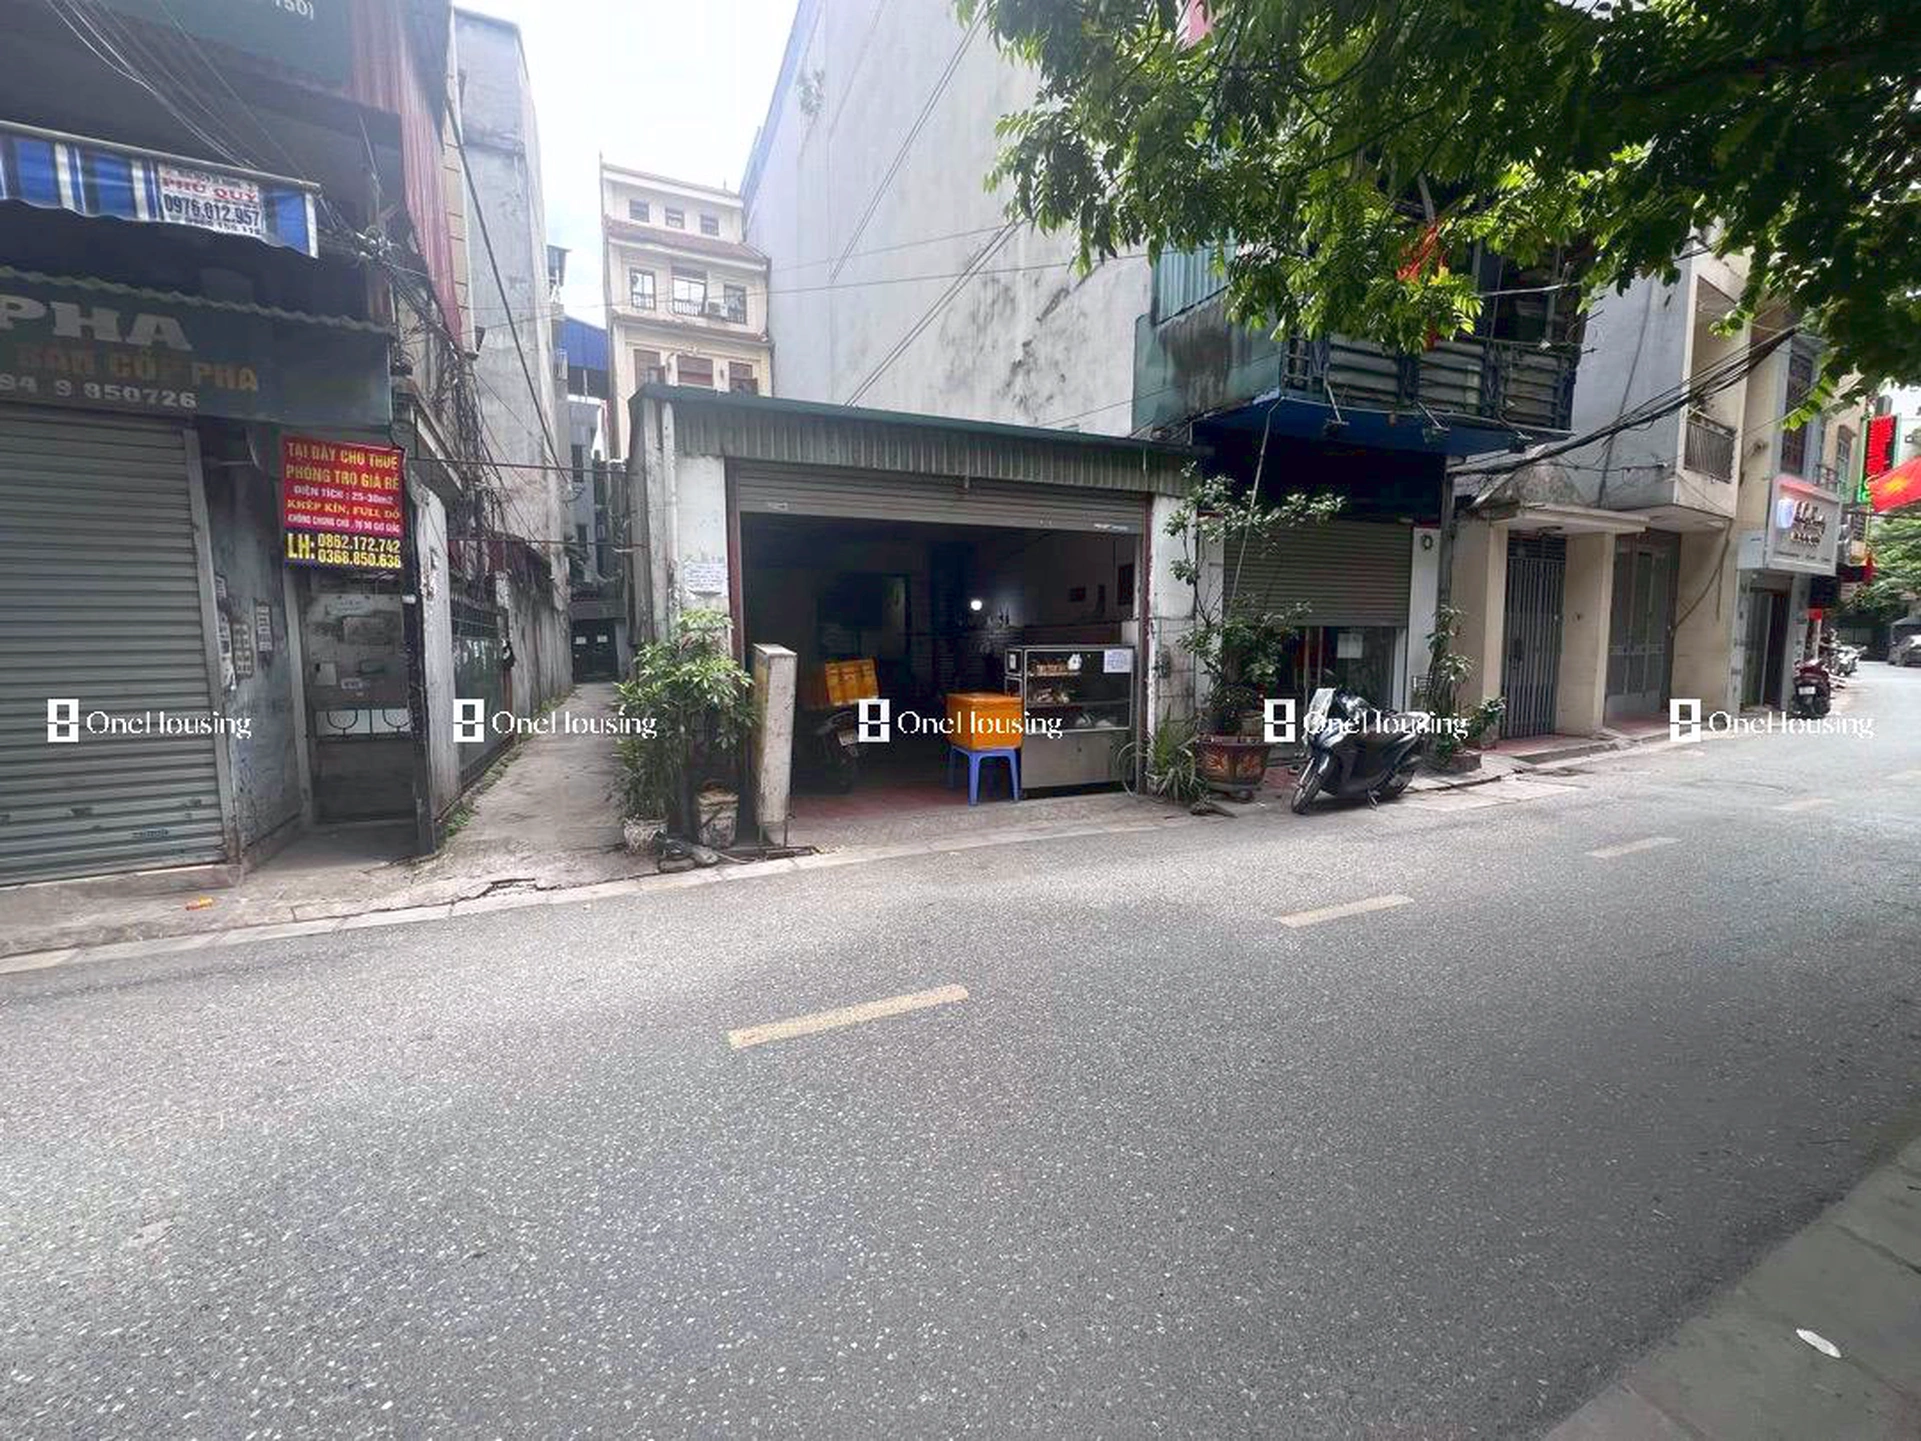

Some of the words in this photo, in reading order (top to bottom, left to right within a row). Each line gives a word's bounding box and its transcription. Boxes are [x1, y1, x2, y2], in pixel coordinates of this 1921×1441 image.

[353, 506, 381, 518] FULL
[287, 533, 316, 559] LH:
[317, 533, 401, 555] 0862.172.742
